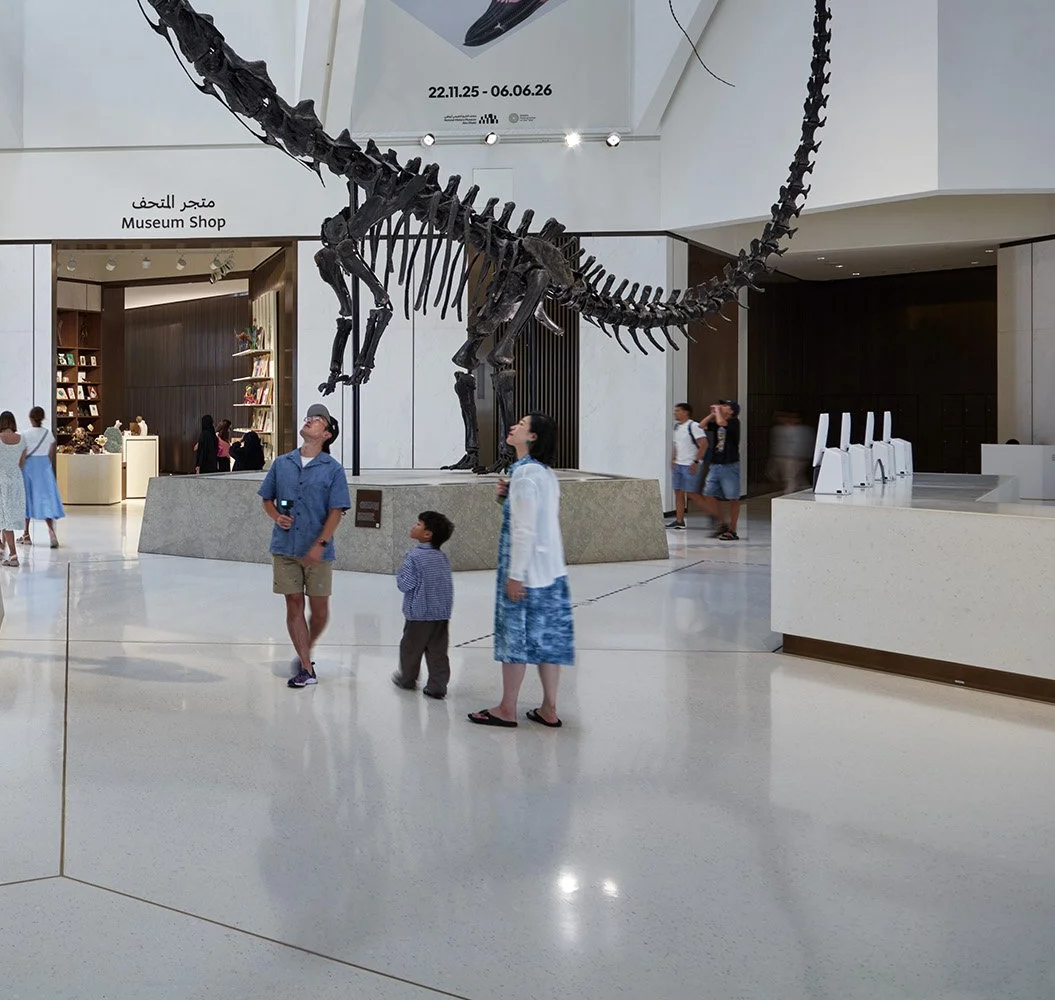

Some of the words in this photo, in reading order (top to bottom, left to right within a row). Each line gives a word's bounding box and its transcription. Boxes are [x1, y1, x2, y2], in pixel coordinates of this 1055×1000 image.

[428, 86, 479, 98] 22.11.25
[490, 84, 553, 97] 06.06.26
[132, 194, 175, 209] المتحف
[180, 198, 215, 212] متجر
[121, 217, 184, 229] Museum
[189, 215, 226, 232] Shop
